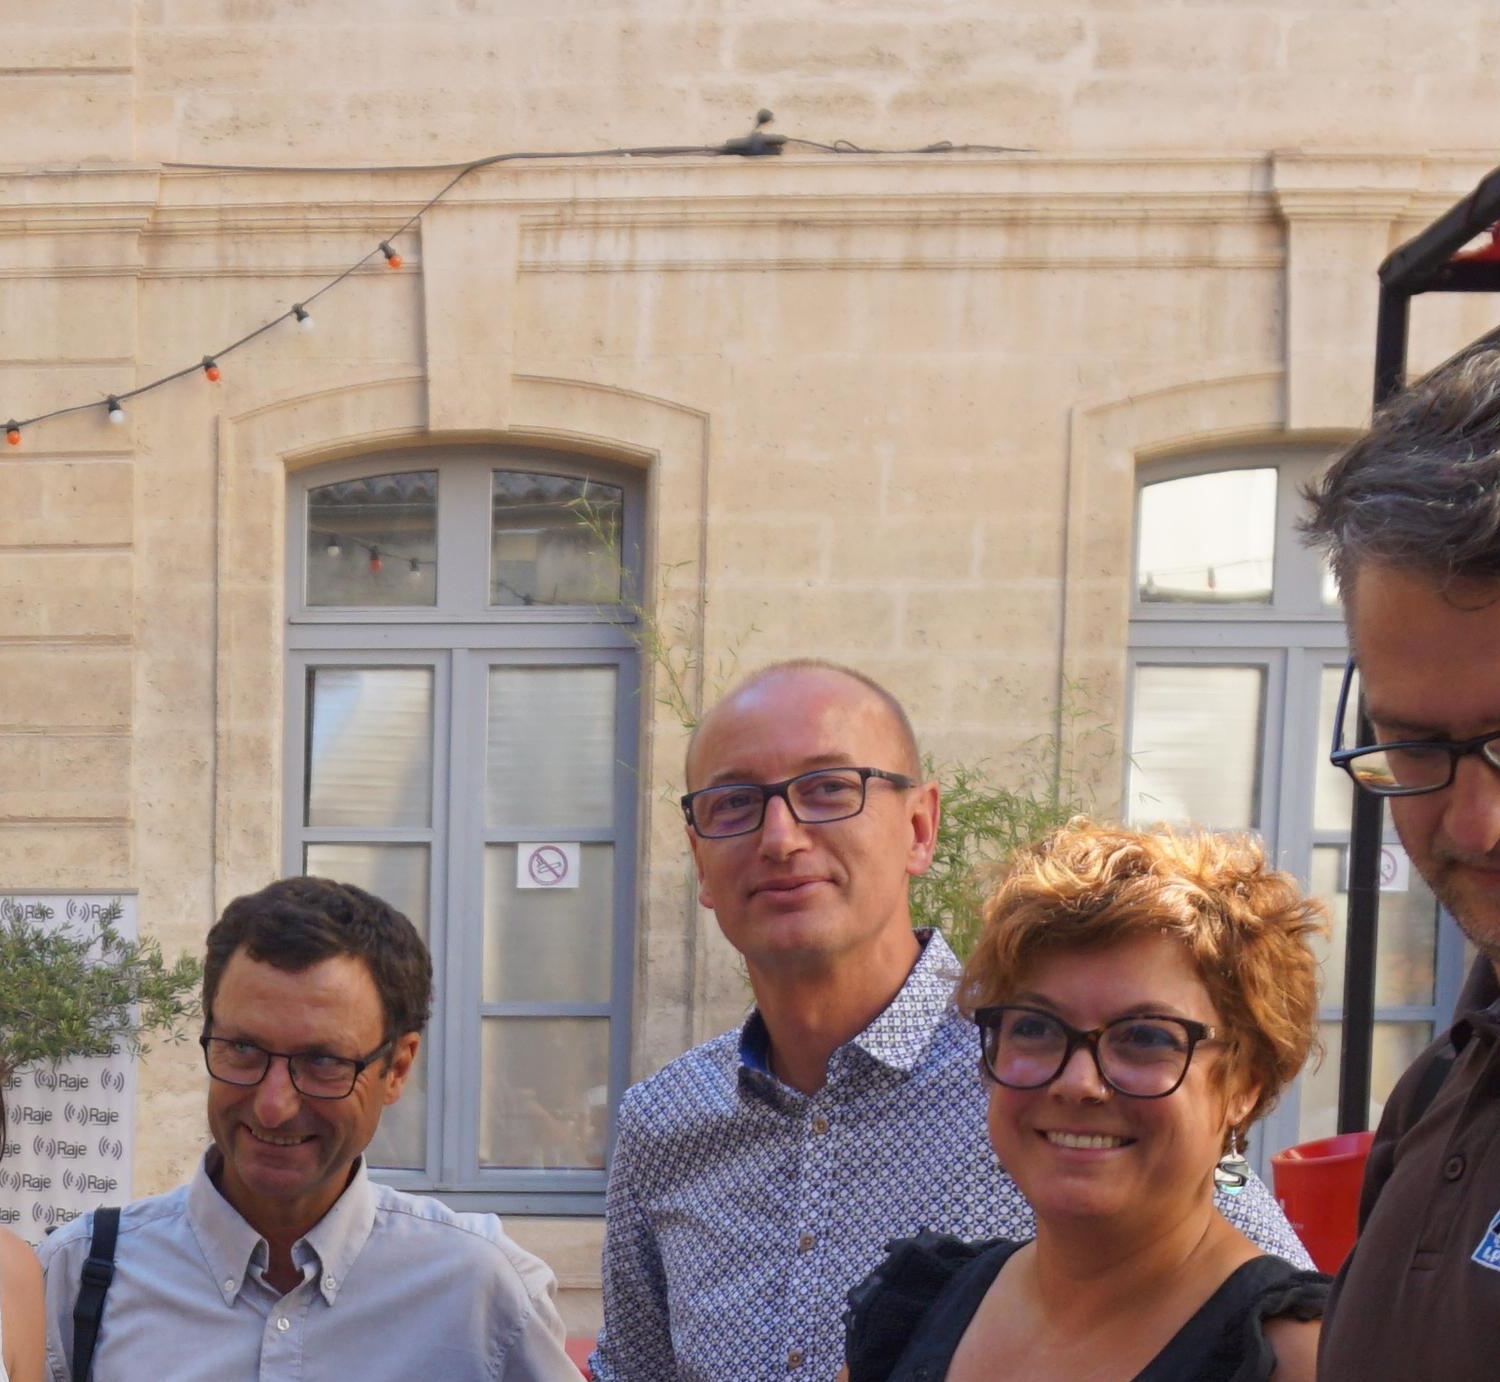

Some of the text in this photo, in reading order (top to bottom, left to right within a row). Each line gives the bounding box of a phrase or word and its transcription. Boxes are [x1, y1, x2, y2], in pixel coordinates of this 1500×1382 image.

[59, 1073, 88, 1091] Raje
[23, 1107, 119, 1125] Raje Raje
[3, 1142, 87, 1158] aje Raje
[22, 1174, 118, 1193] Raje Raje
